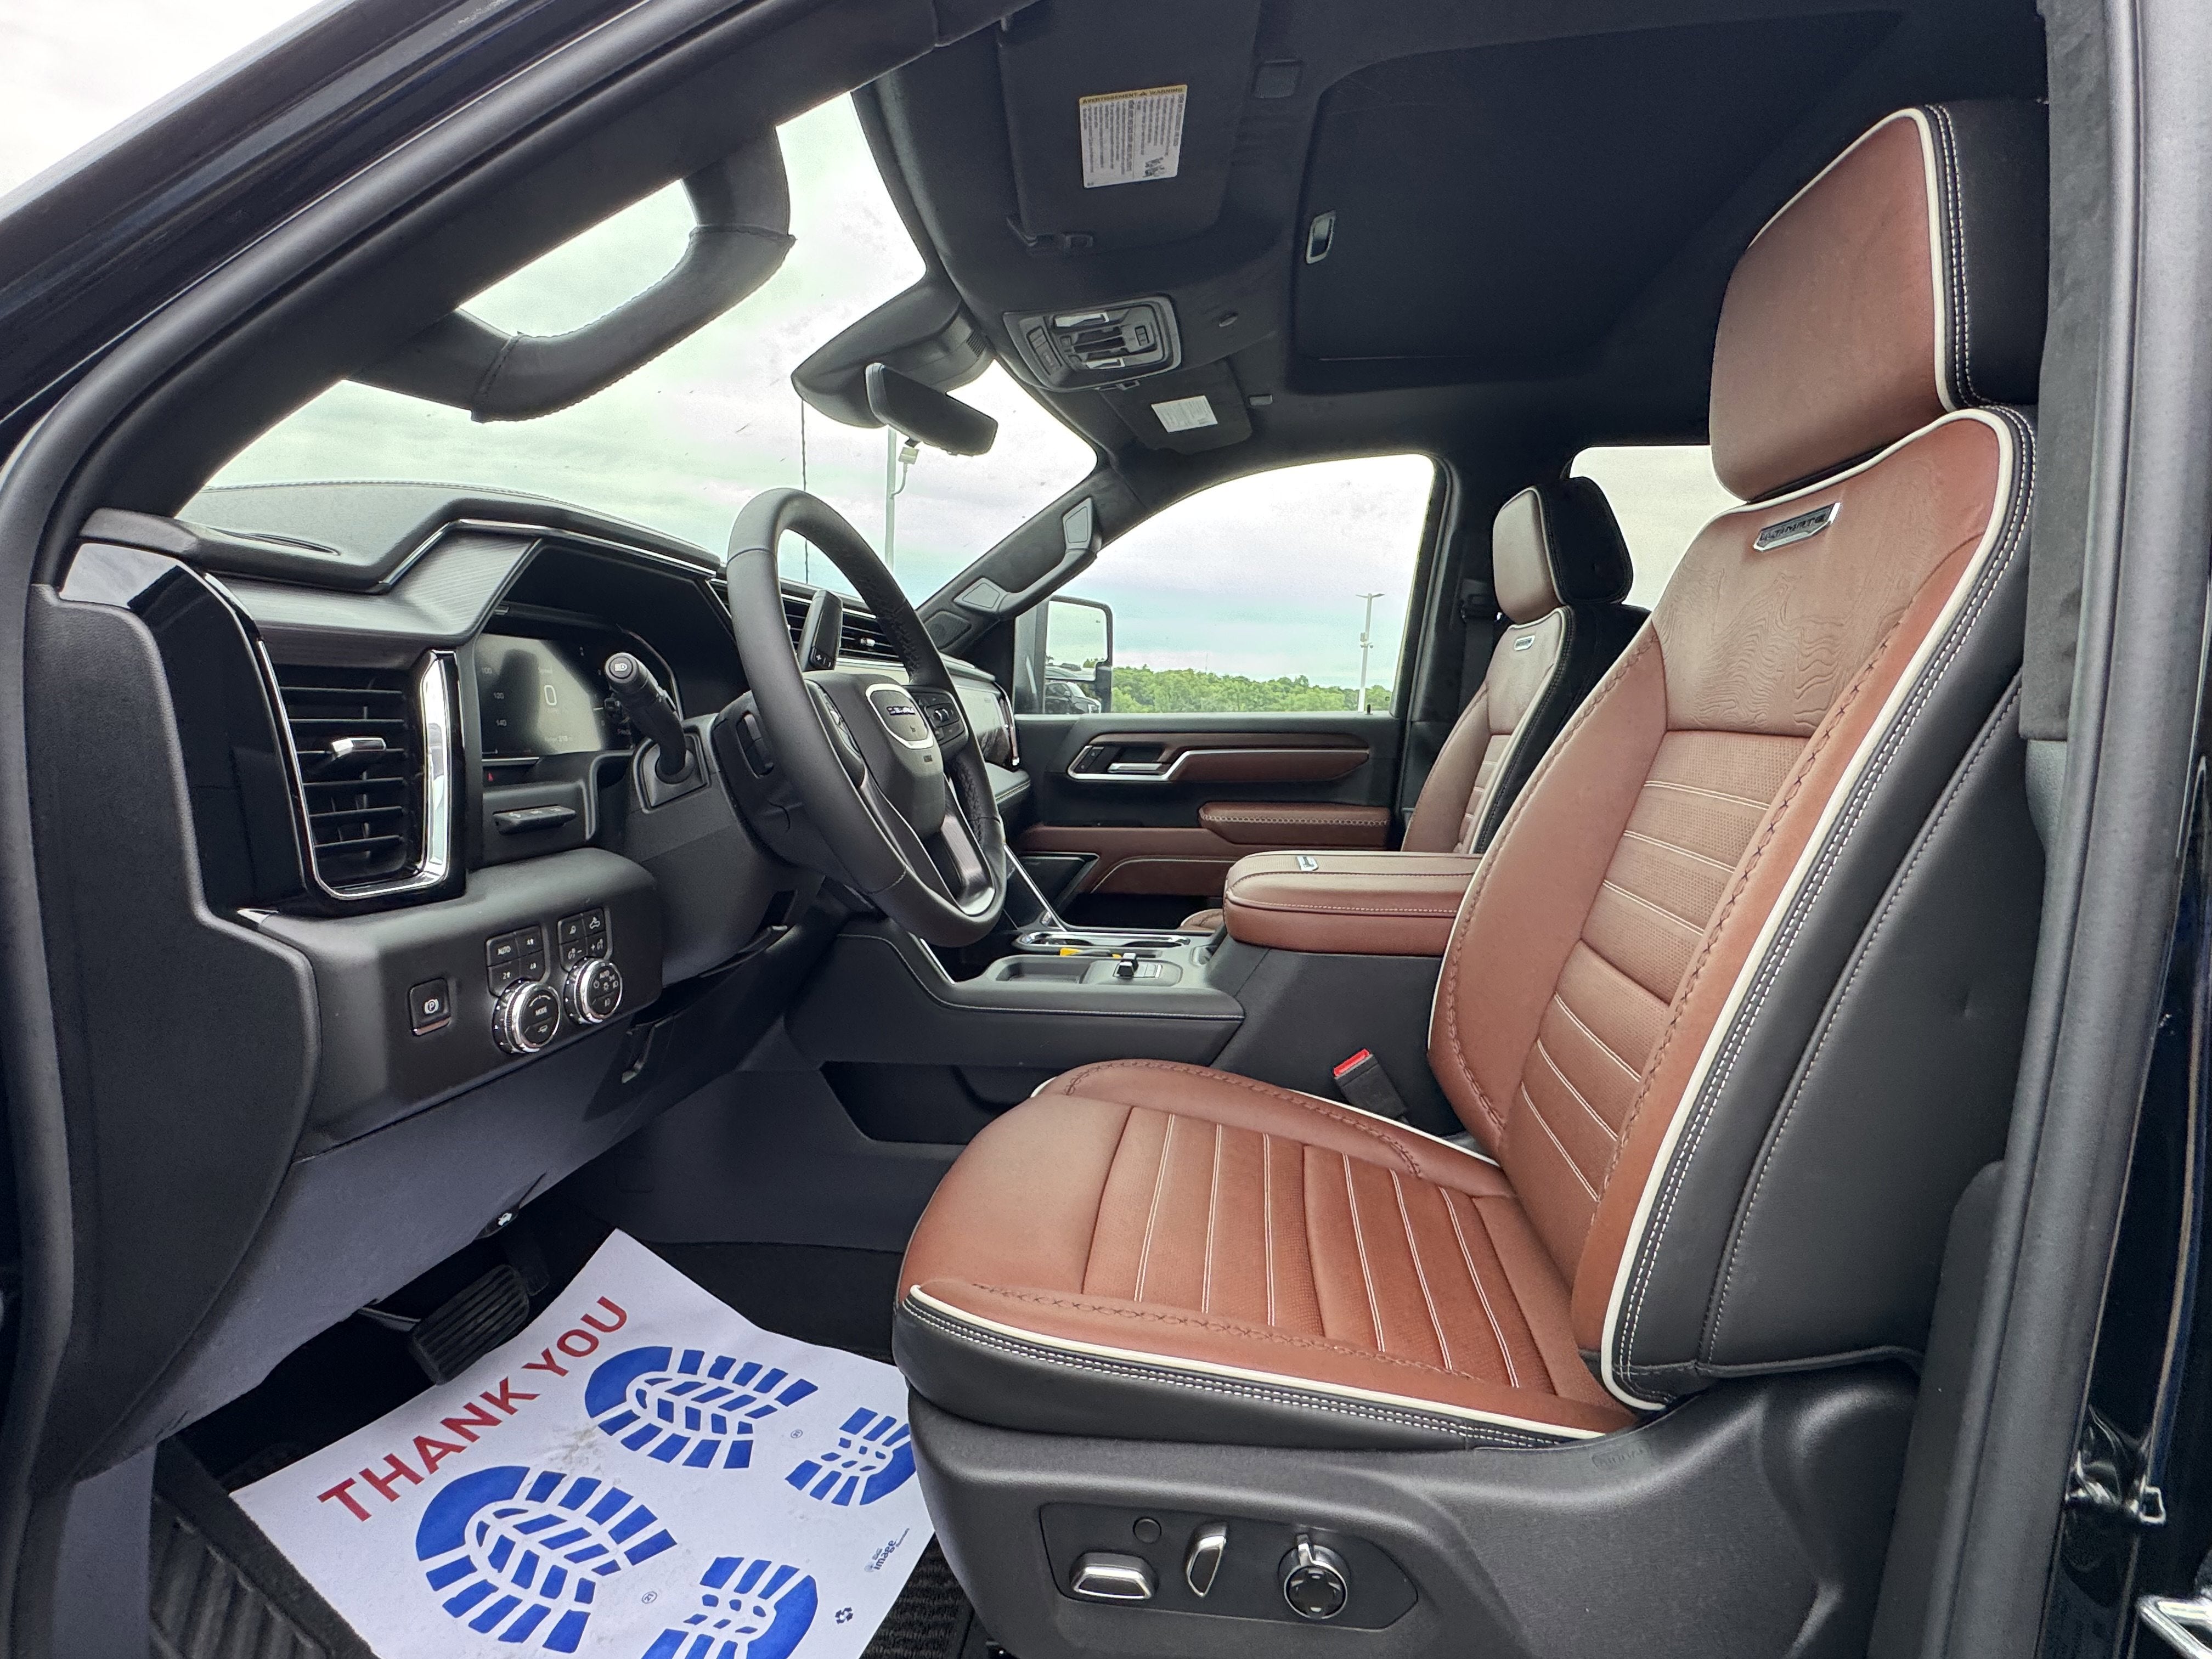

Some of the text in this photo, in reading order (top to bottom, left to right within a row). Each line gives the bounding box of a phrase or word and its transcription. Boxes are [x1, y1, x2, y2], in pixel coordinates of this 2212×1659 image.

[544, 685, 557, 706] 0
[316, 1296, 628, 1522] THANK YOU
[871, 1540, 896, 1570] image
